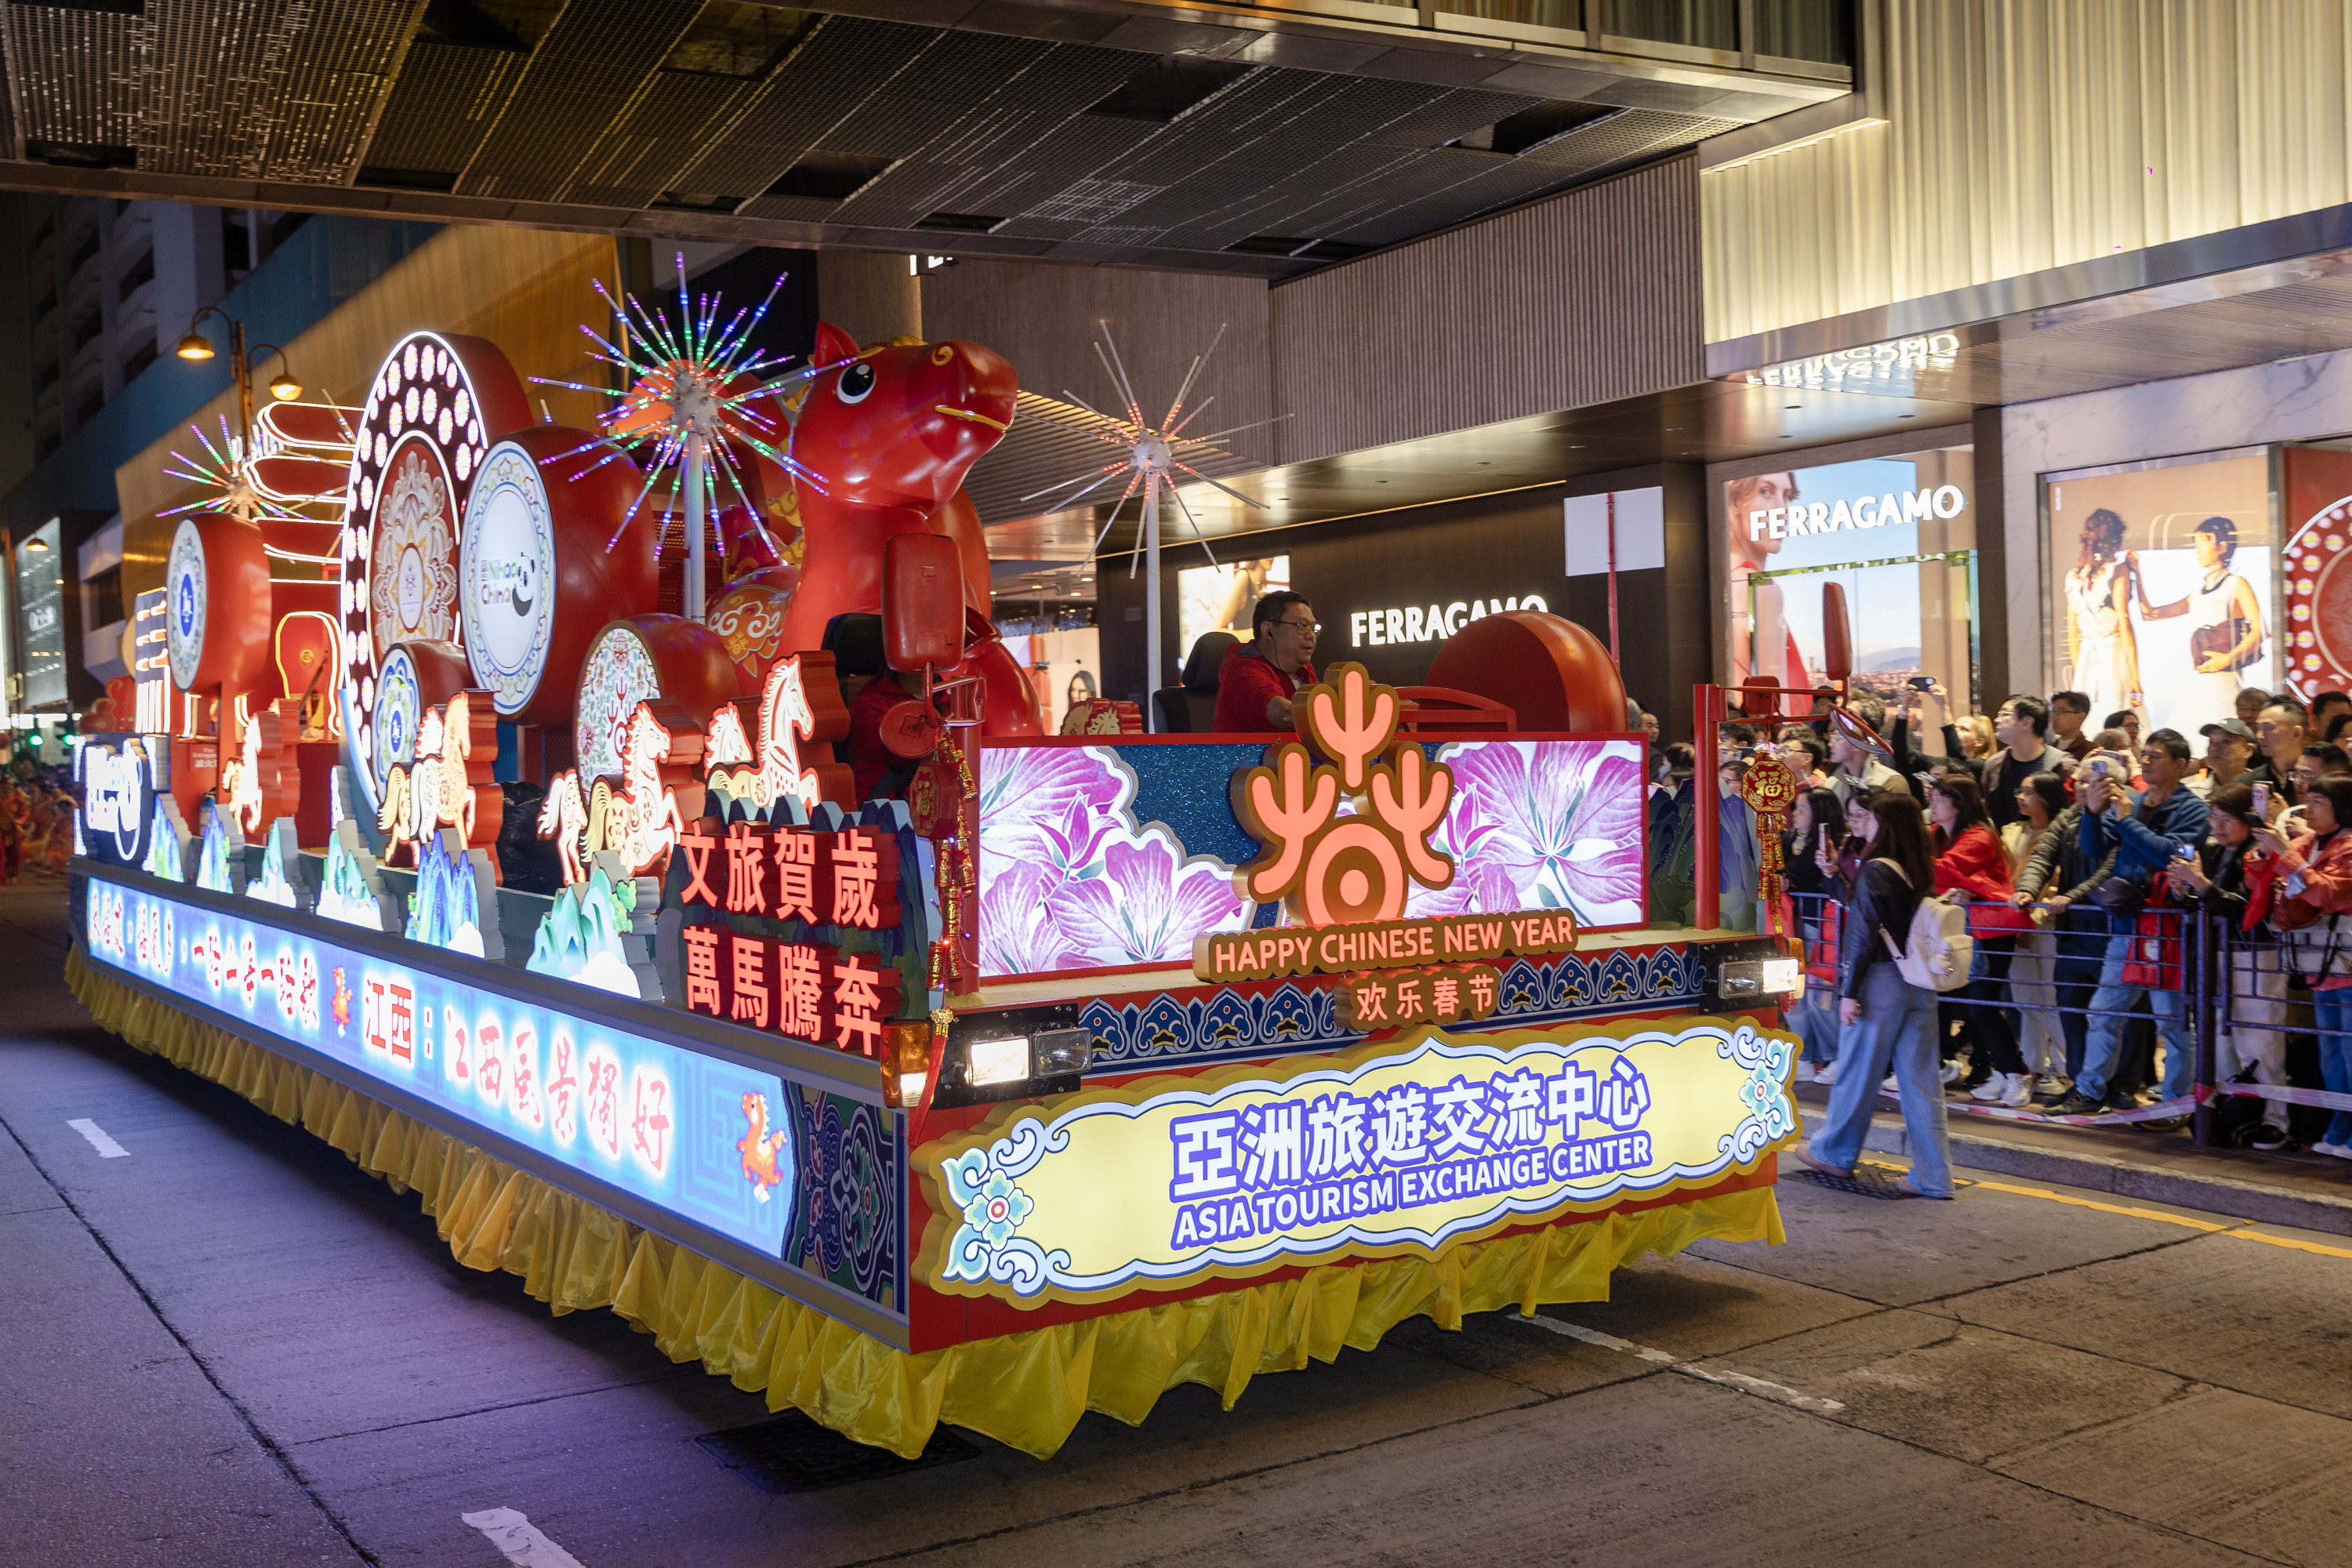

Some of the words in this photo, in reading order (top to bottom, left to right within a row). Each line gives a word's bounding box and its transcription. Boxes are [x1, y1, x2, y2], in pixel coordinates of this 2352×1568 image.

[1749, 485, 1965, 542] FERRAGAMO
[1755, 771, 1783, 797] 福
[680, 820, 879, 928] 文旅賀歲
[1215, 936, 1312, 974] HAPPY
[1320, 926, 1435, 964] CHINESE
[1444, 920, 1504, 954] NEW
[1511, 916, 1573, 947] YEAR
[683, 925, 882, 1055] 萬馬騰奔
[1356, 973, 1495, 1022] 欢乐春节
[1174, 1058, 1649, 1198] 亞洲旅遊交流中心
[1175, 1207, 1250, 1245] ASIA
[1257, 1177, 1394, 1229] TOURISM
[1404, 1156, 1547, 1202] EXCHANGE
[1552, 1134, 1650, 1176] CENTER
